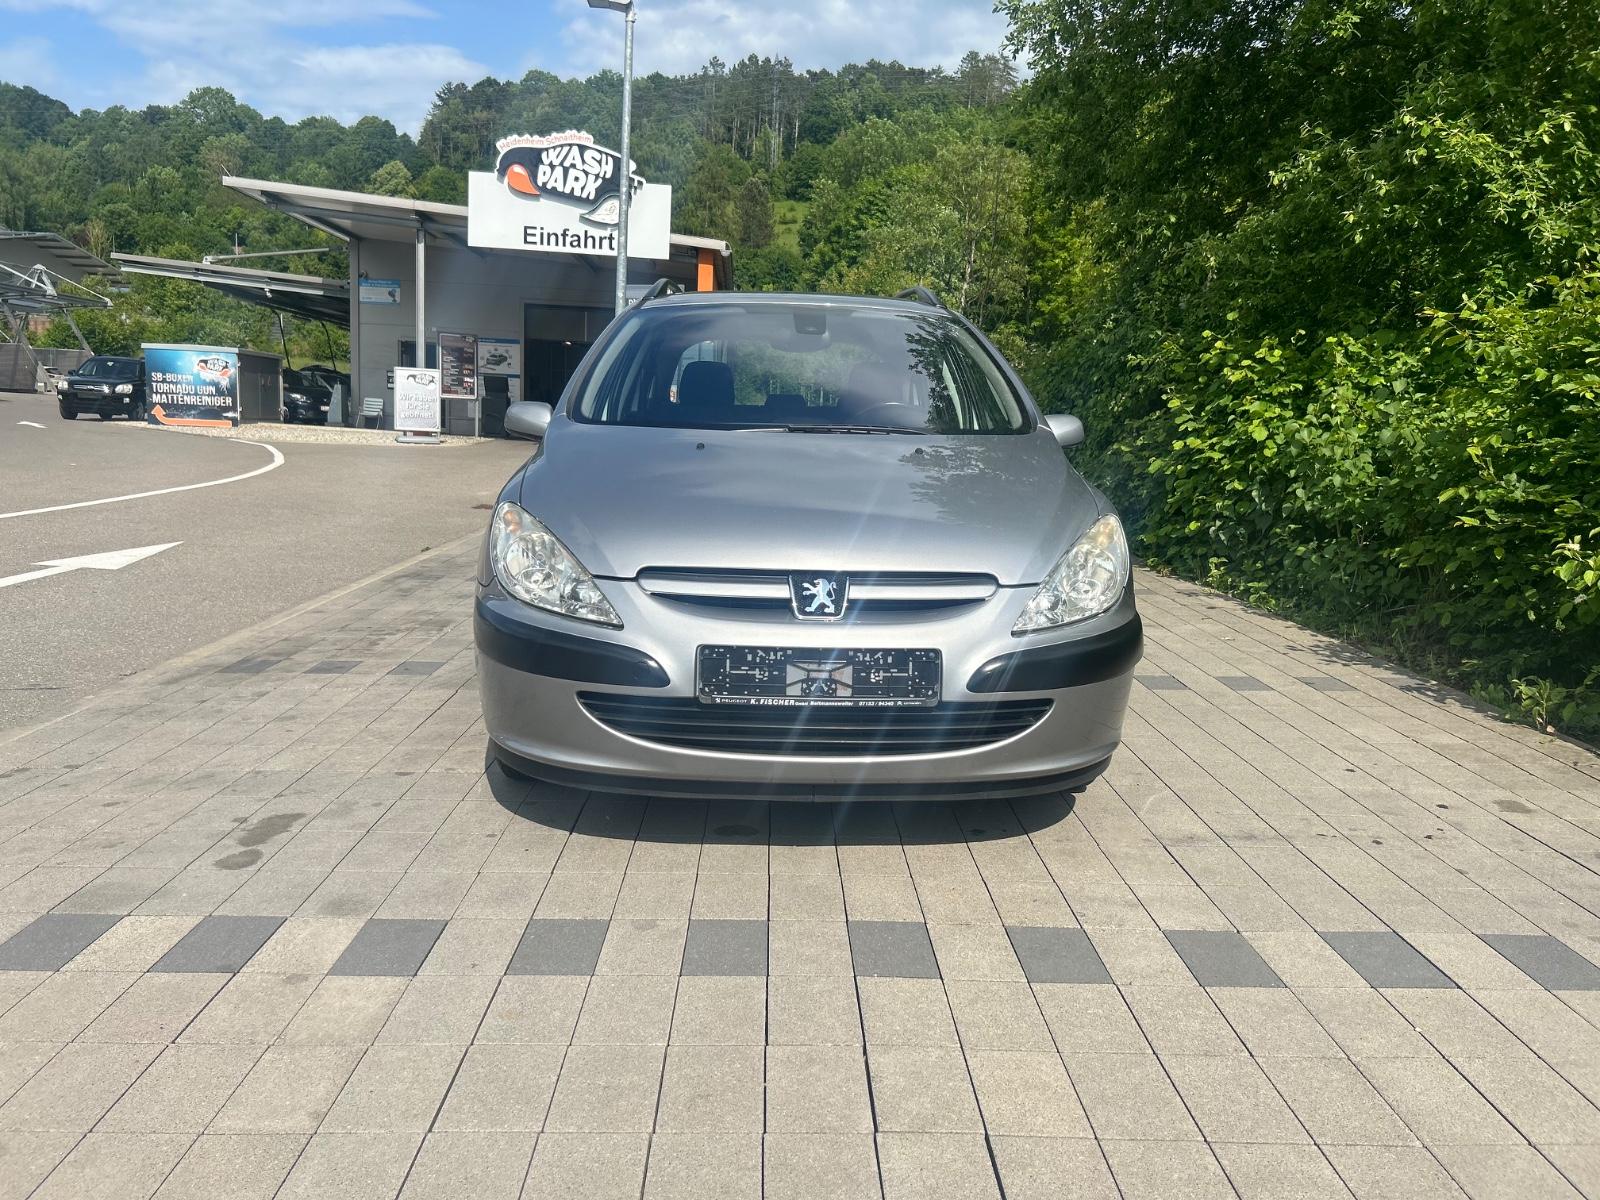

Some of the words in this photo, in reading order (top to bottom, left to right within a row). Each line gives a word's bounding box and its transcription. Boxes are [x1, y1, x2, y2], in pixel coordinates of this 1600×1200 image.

[499, 136, 544, 150] Heidenheim
[545, 133, 592, 145] Schnaitheim
[541, 145, 613, 179] WASH
[537, 164, 603, 200] PARK
[523, 225, 616, 251] Einfahrt
[151, 372, 193, 383] SB-BOXEN
[151, 382, 195, 394] TORNADO
[197, 385, 216, 394] GUN
[152, 393, 233, 407] MATTENREINIGER
